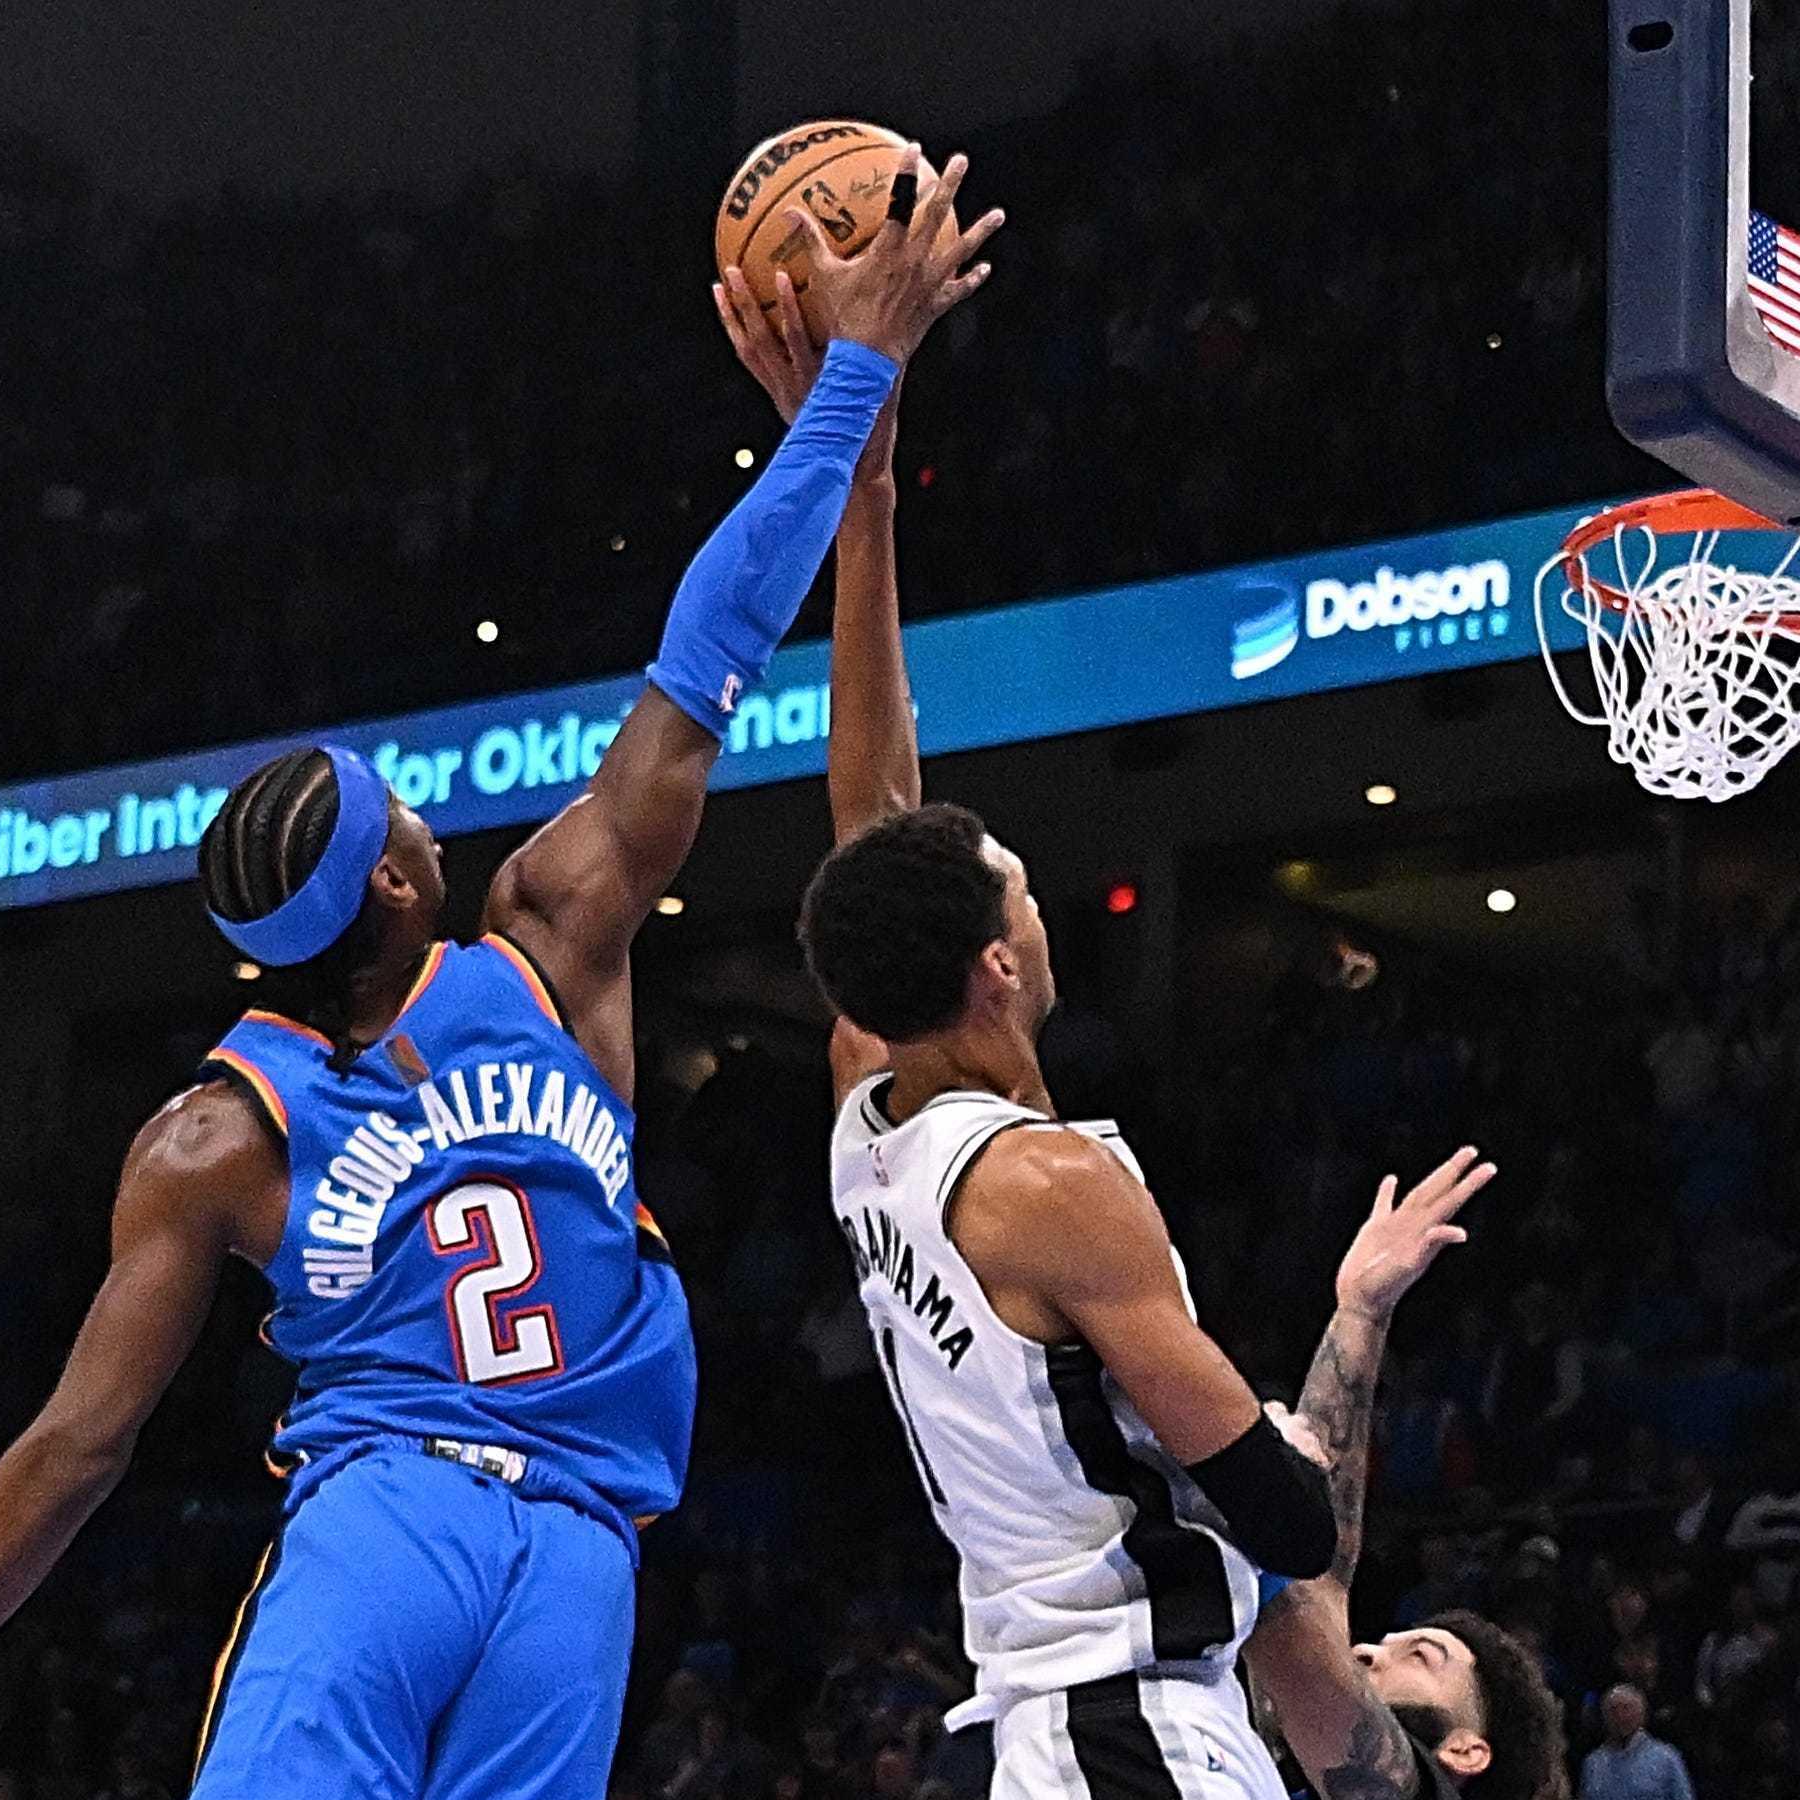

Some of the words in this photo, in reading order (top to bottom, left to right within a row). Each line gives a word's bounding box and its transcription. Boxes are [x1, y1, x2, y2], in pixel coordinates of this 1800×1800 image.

[1305, 558, 1511, 640] Dobson
[302, 1062, 633, 1300] GILGEOUS-ALEXANDER
[426, 1172, 566, 1390] 2
